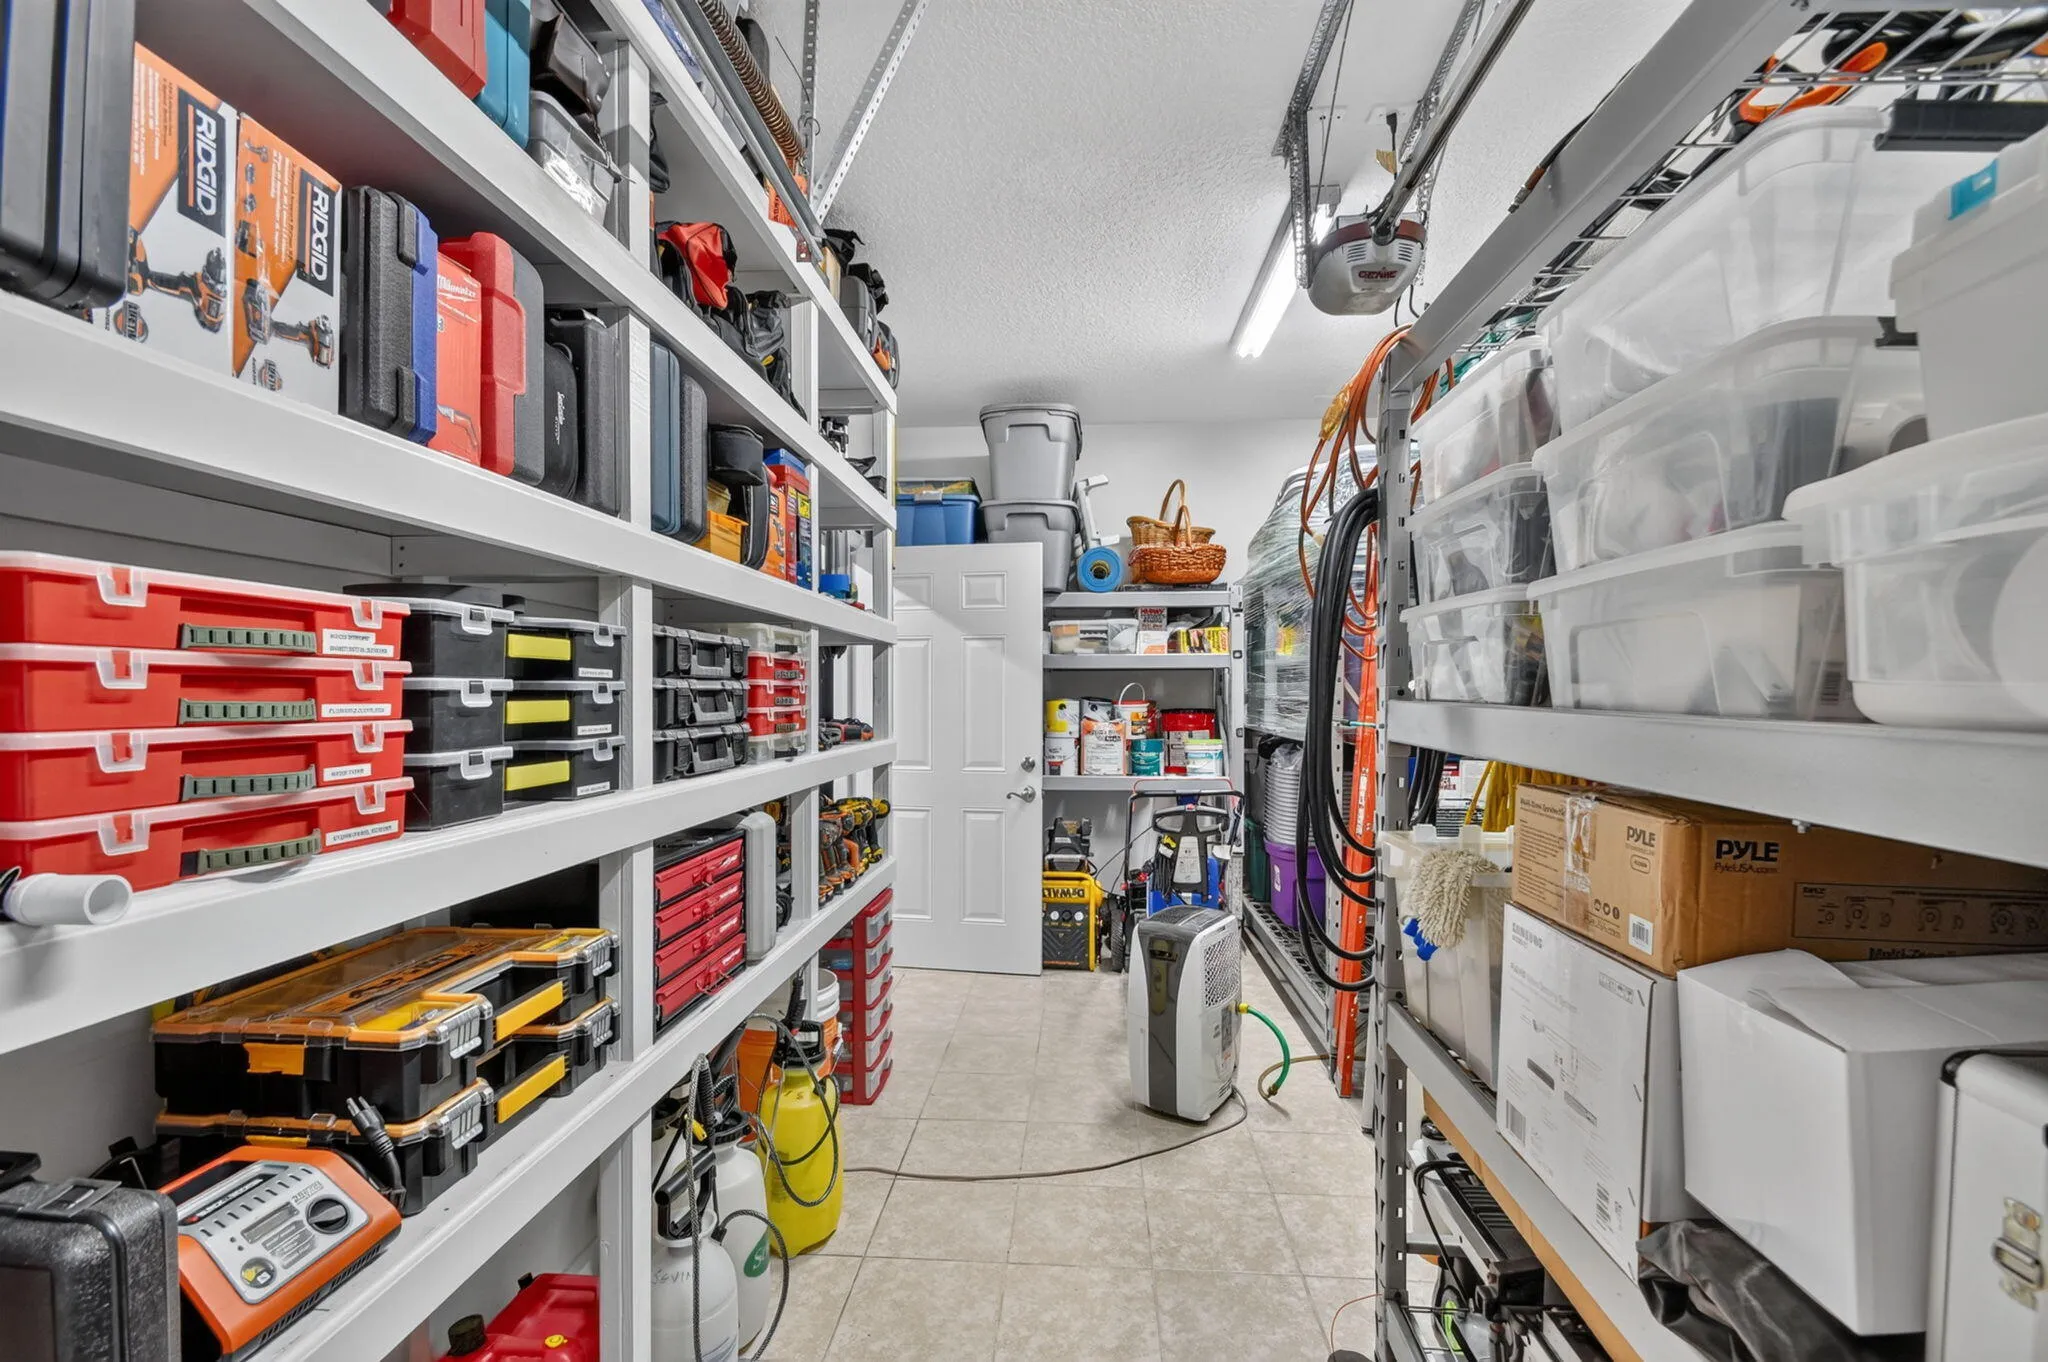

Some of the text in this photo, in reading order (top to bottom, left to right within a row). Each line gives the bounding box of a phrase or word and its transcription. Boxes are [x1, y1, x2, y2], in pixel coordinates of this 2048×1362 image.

[195, 108, 217, 216] RIDGID
[311, 186, 329, 282] RIDGID
[1626, 825, 1656, 848] PYLE
[1715, 839, 1779, 862] PYLE
